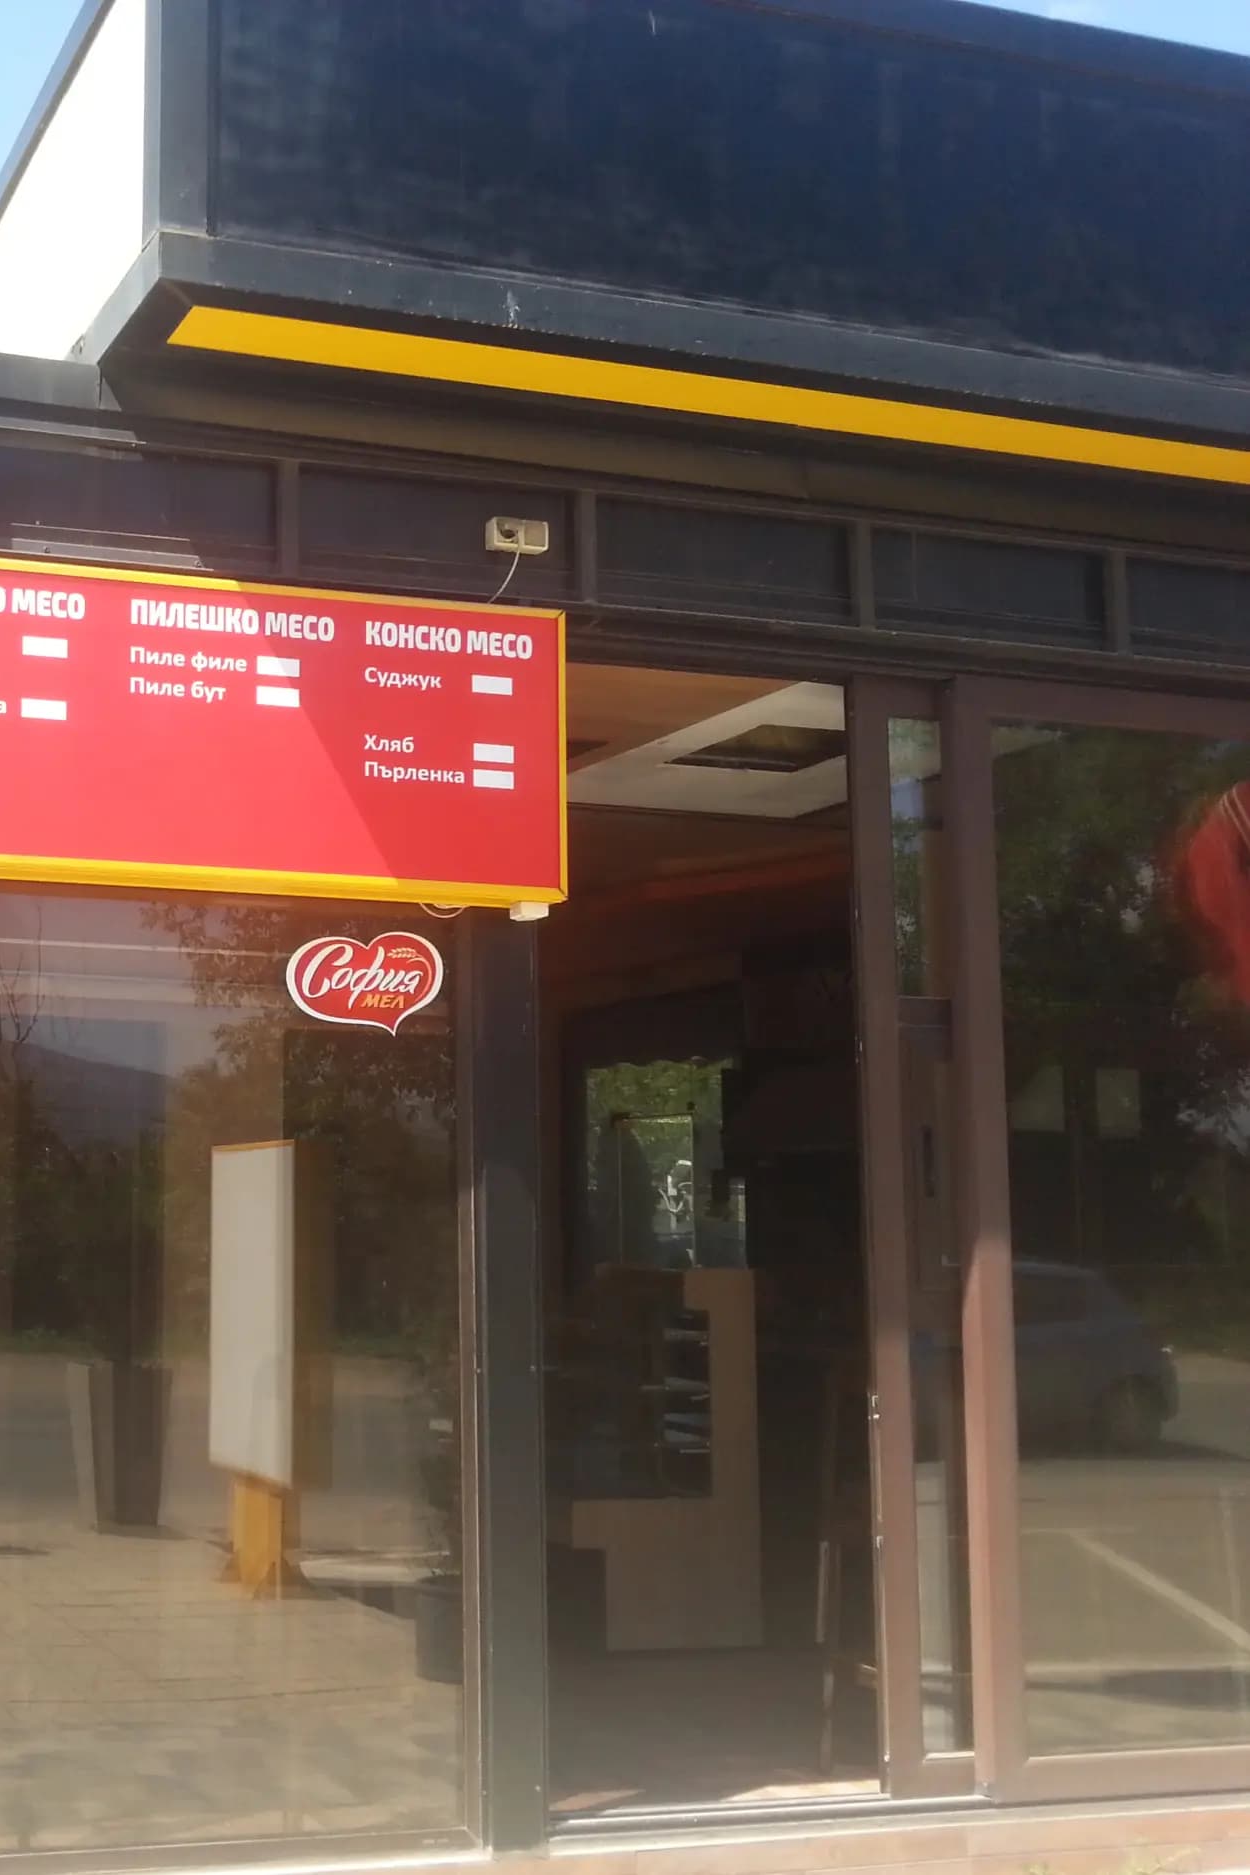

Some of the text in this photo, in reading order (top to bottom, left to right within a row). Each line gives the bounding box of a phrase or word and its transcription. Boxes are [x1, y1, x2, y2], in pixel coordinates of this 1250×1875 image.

[11, 588, 86, 620] МЕСО
[130, 598, 335, 642] ПИЛЕШКО МЕСО
[365, 620, 533, 660] КОНСКО МЕСО
[129, 646, 248, 672] Пиле филе
[129, 676, 226, 703] Пиле бут
[364, 666, 442, 691] Суджук
[363, 734, 415, 753] Хляб
[364, 760, 465, 784] Пърленка
[301, 943, 423, 1009] София
